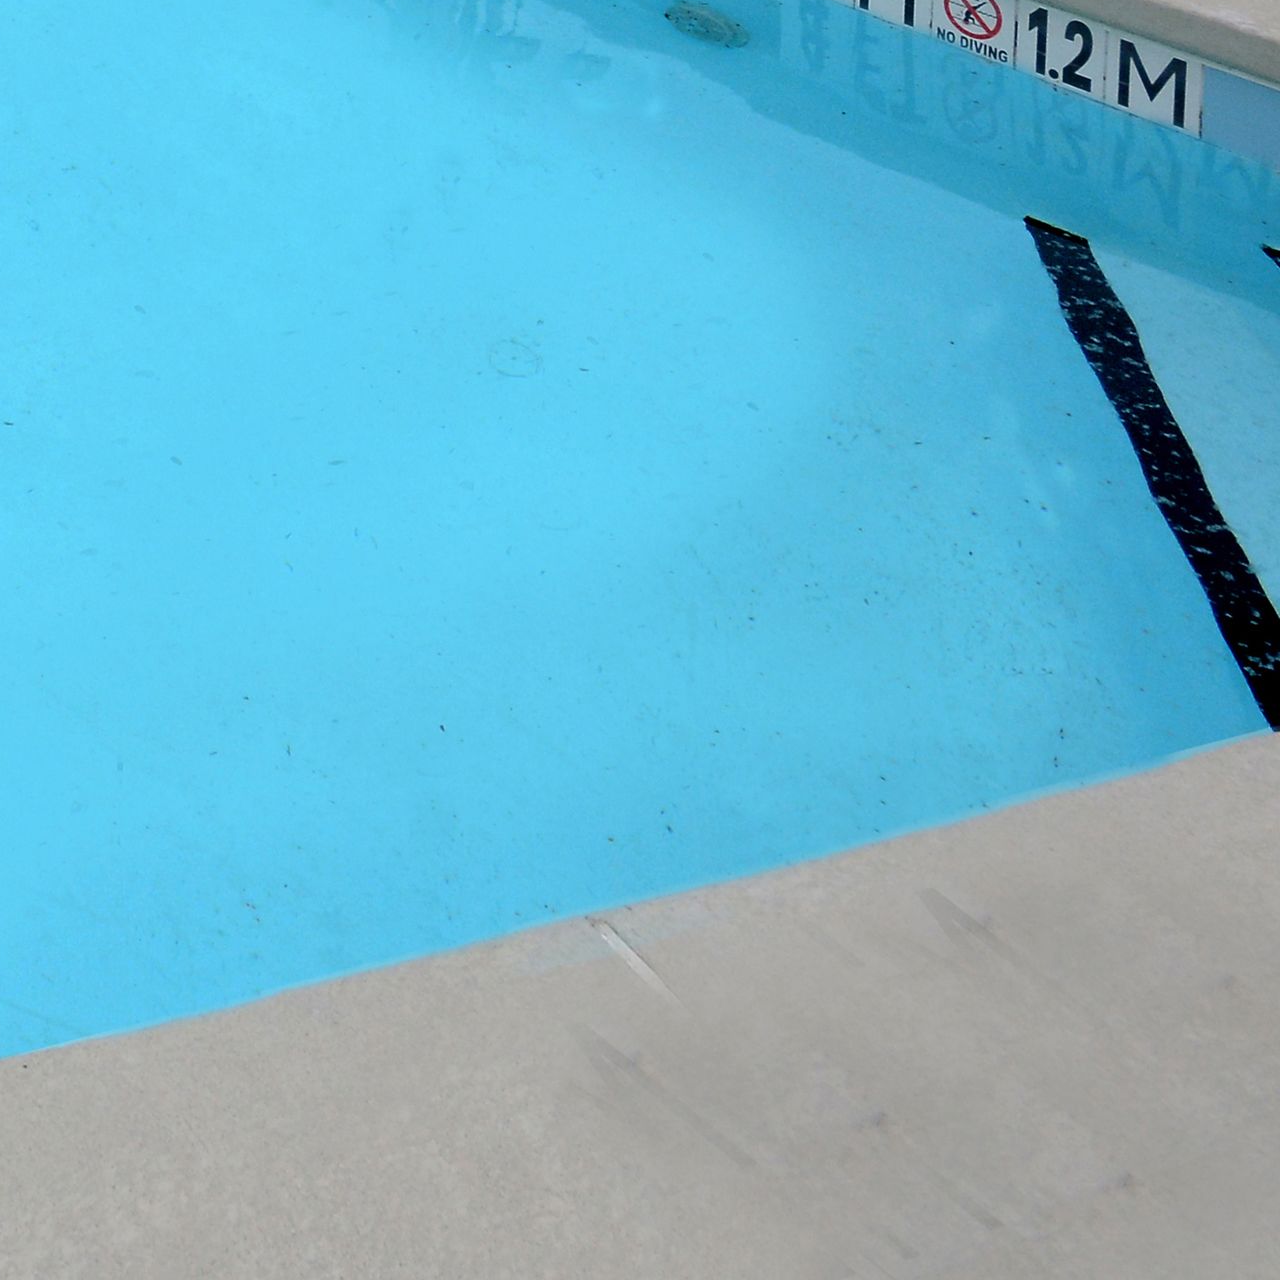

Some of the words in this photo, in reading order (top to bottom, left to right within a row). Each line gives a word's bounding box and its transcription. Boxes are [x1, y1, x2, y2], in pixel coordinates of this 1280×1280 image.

[937, 26, 955, 44] NO
[960, 36, 1008, 63] DIVING
[1027, 8, 1093, 93] 1.2
[1118, 39, 1187, 128] M
